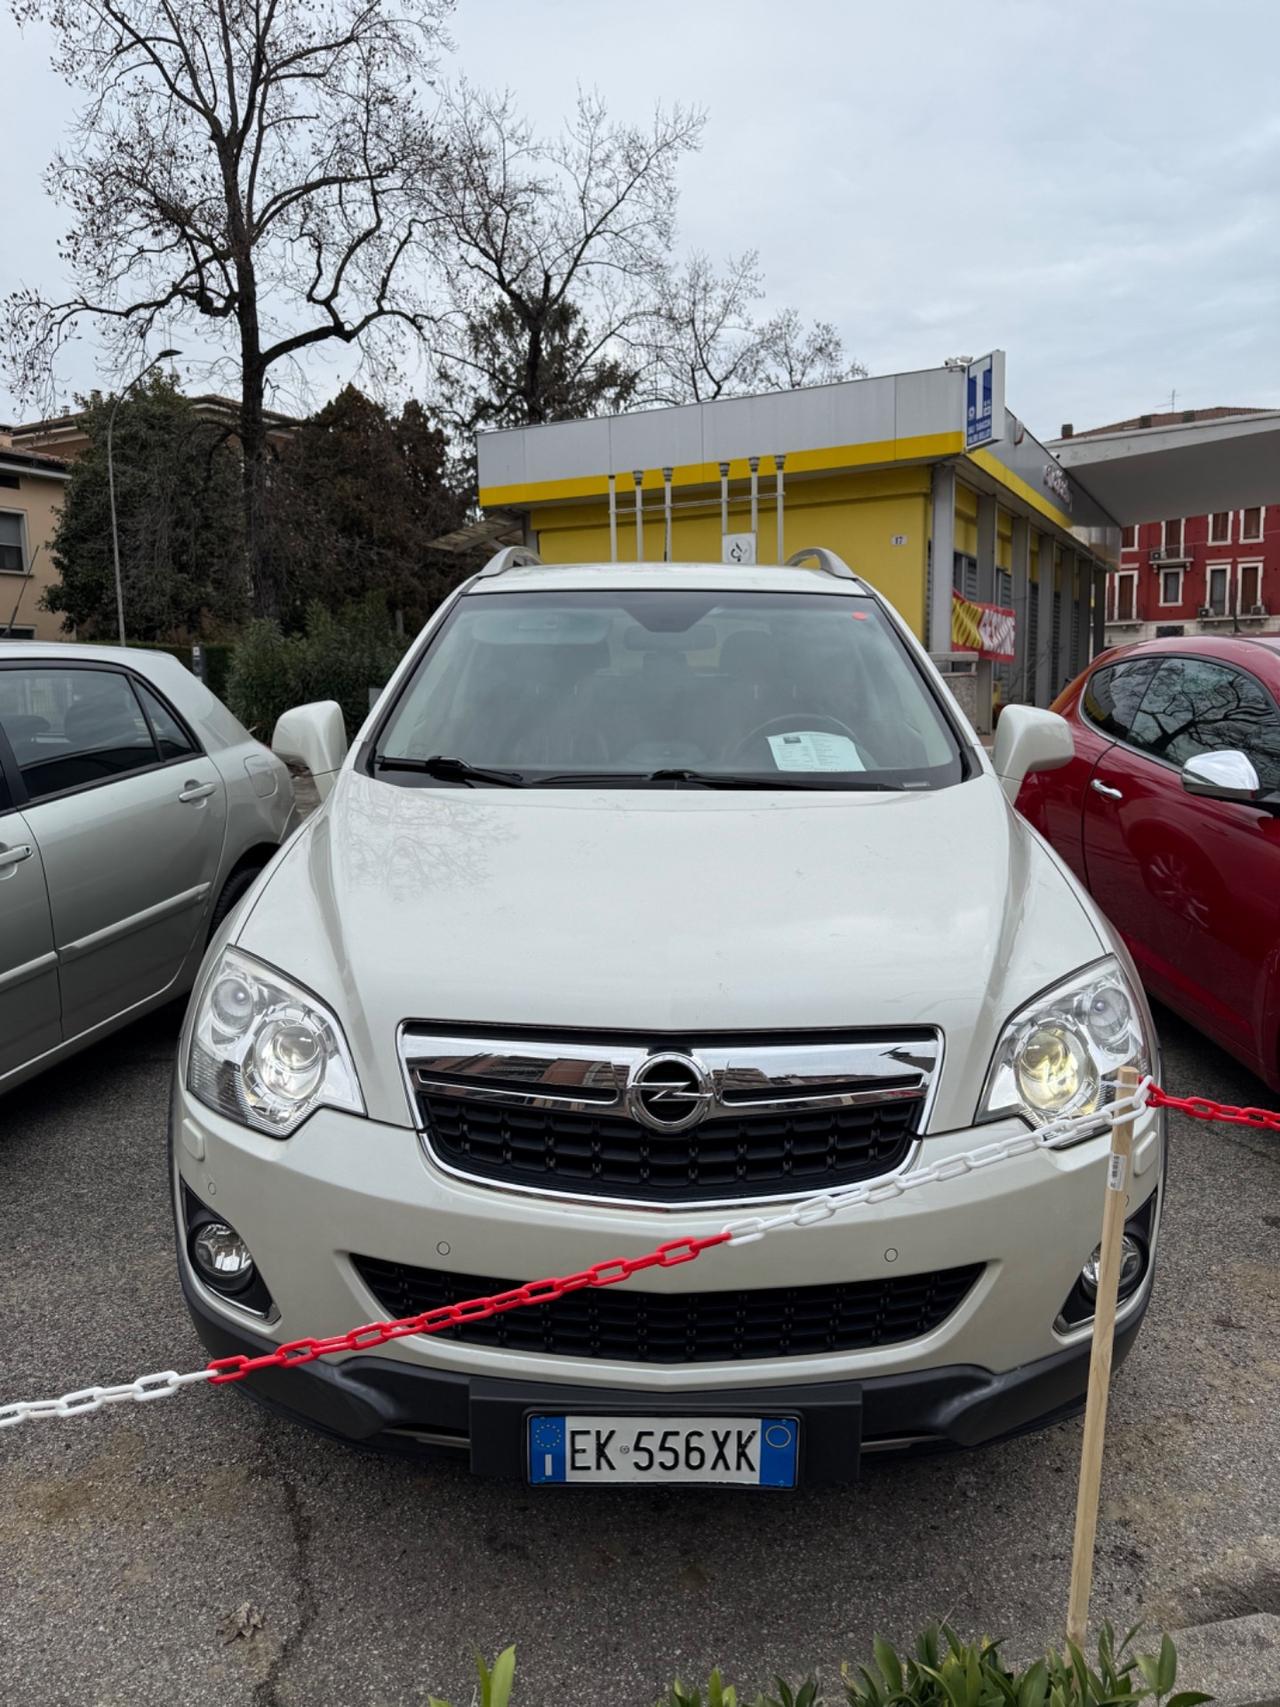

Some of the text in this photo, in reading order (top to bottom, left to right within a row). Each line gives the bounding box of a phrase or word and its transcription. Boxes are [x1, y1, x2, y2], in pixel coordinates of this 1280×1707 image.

[969, 357, 991, 419] T
[569, 1429, 758, 1472] EK 556XK
